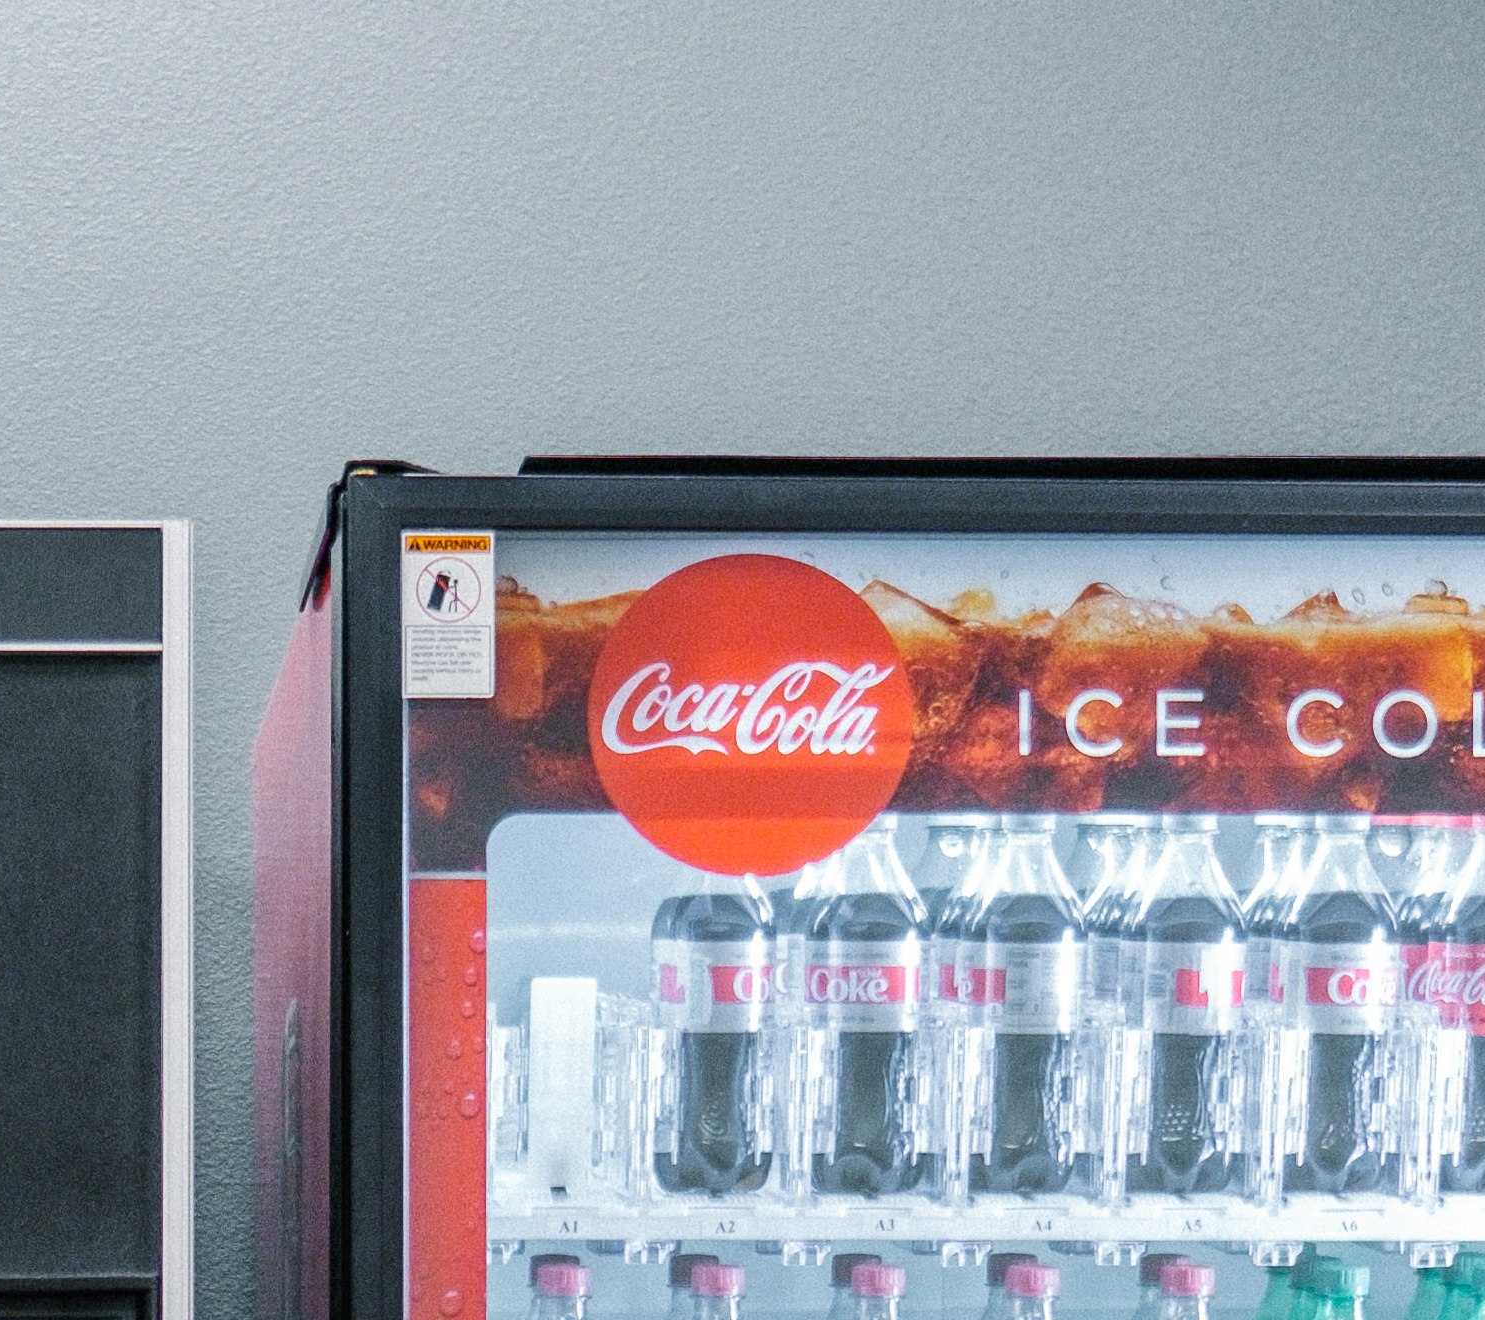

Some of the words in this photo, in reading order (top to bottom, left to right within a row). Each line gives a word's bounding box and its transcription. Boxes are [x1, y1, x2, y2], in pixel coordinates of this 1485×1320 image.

[422, 538, 489, 552] WARNING
[601, 662, 894, 755] Coca-Cola
[1017, 688, 1206, 758] ICE
[809, 966, 888, 1002] Coke
[560, 1221, 579, 1234] A1
[715, 1222, 735, 1235] A2
[875, 1219, 896, 1232] A3
[1032, 1219, 1053, 1232] A4
